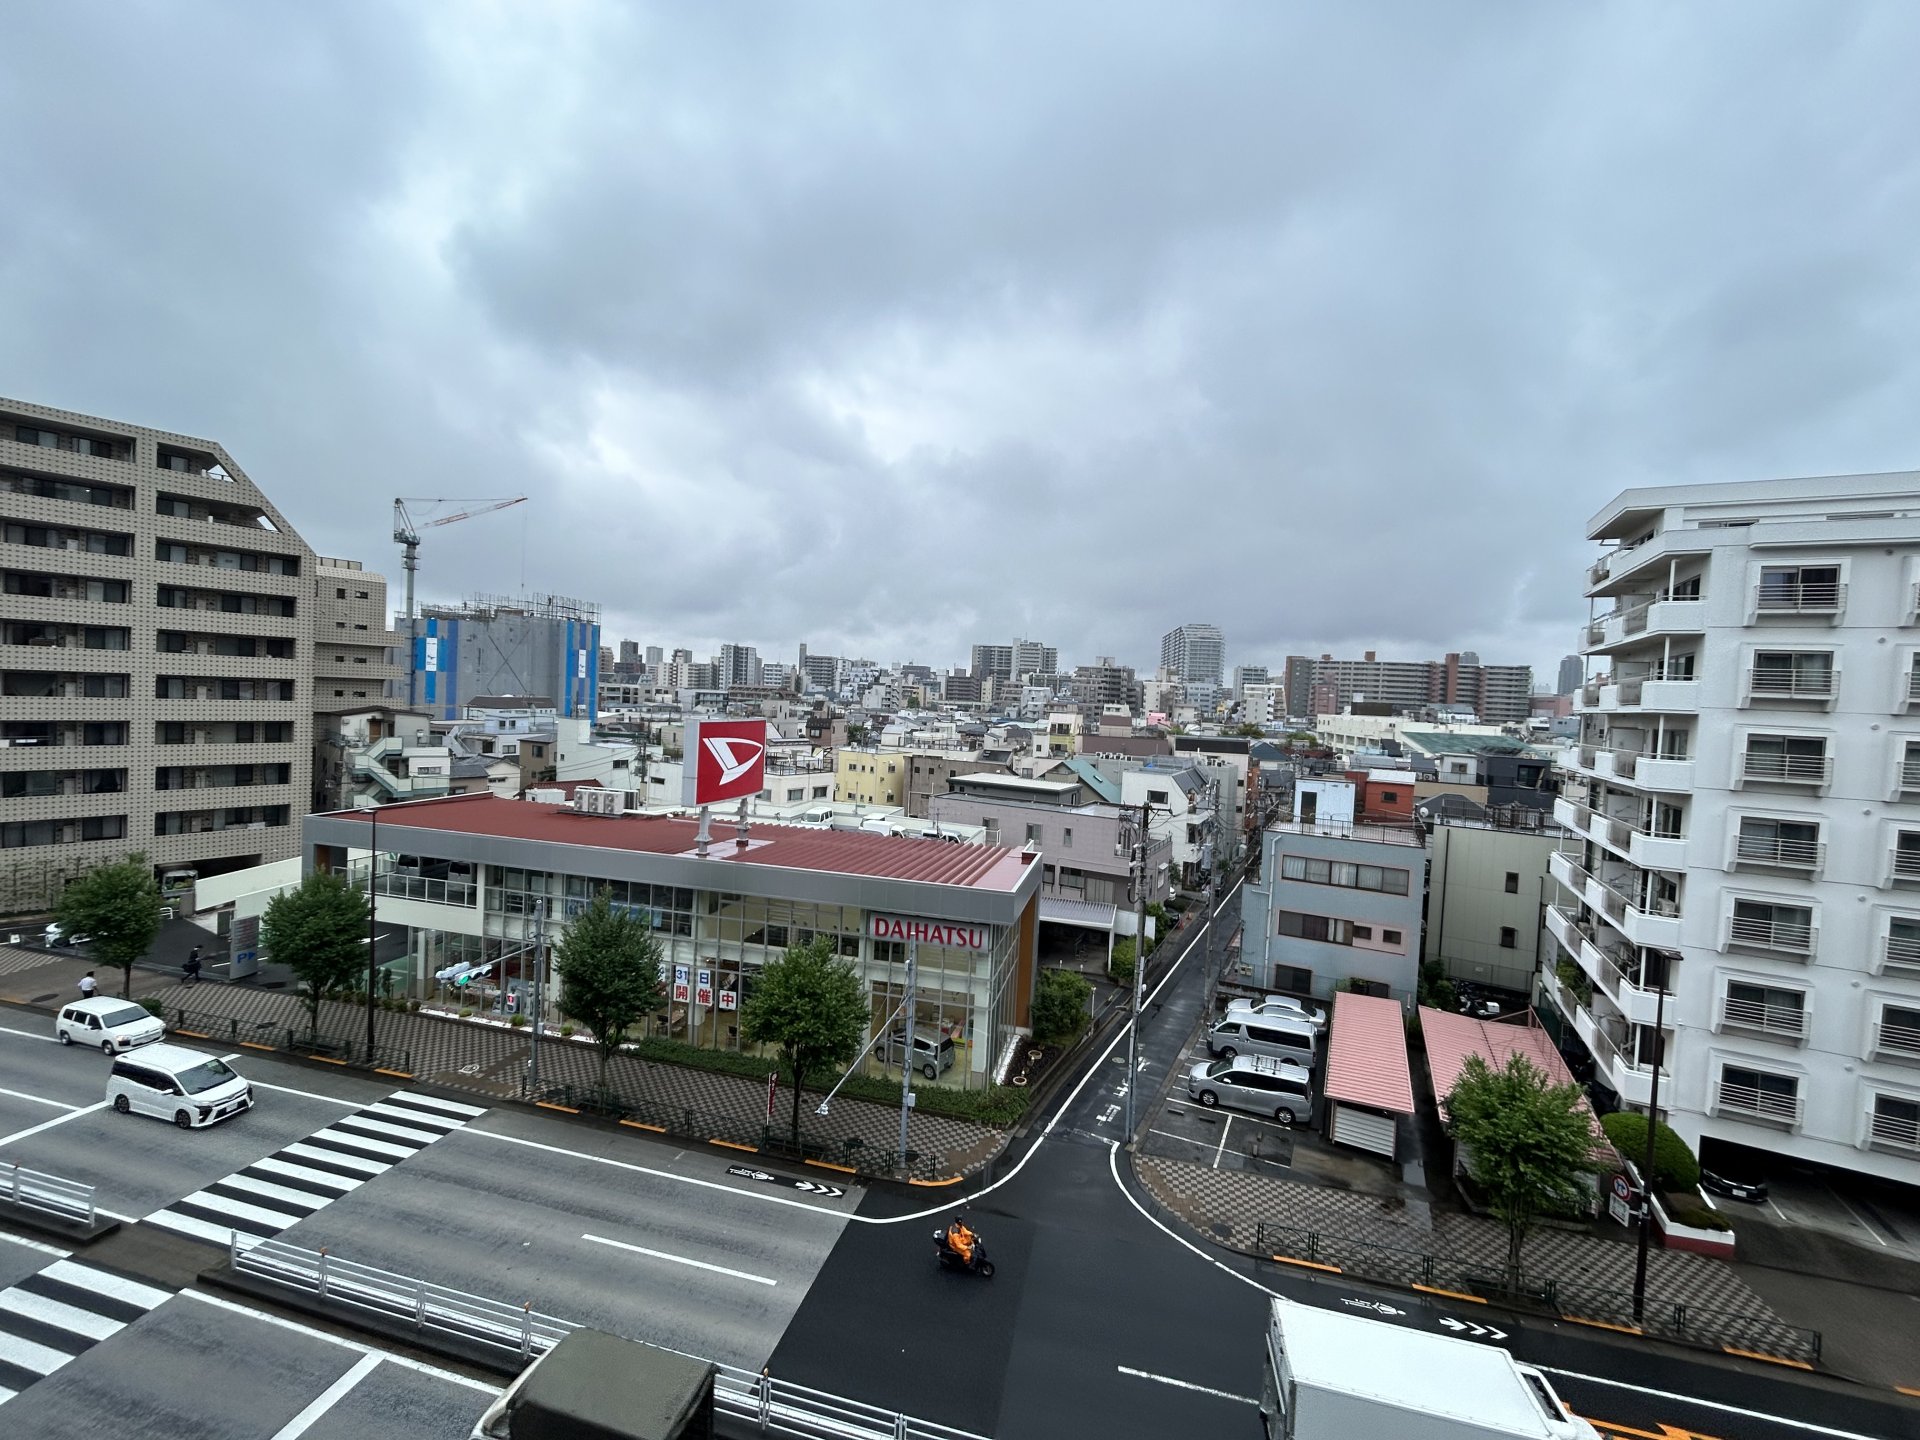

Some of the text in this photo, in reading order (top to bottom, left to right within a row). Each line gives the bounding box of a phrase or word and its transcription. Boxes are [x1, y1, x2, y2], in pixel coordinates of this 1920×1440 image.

[874, 917, 983, 949] DAIHATSU
[676, 985, 734, 1008] 開催中
